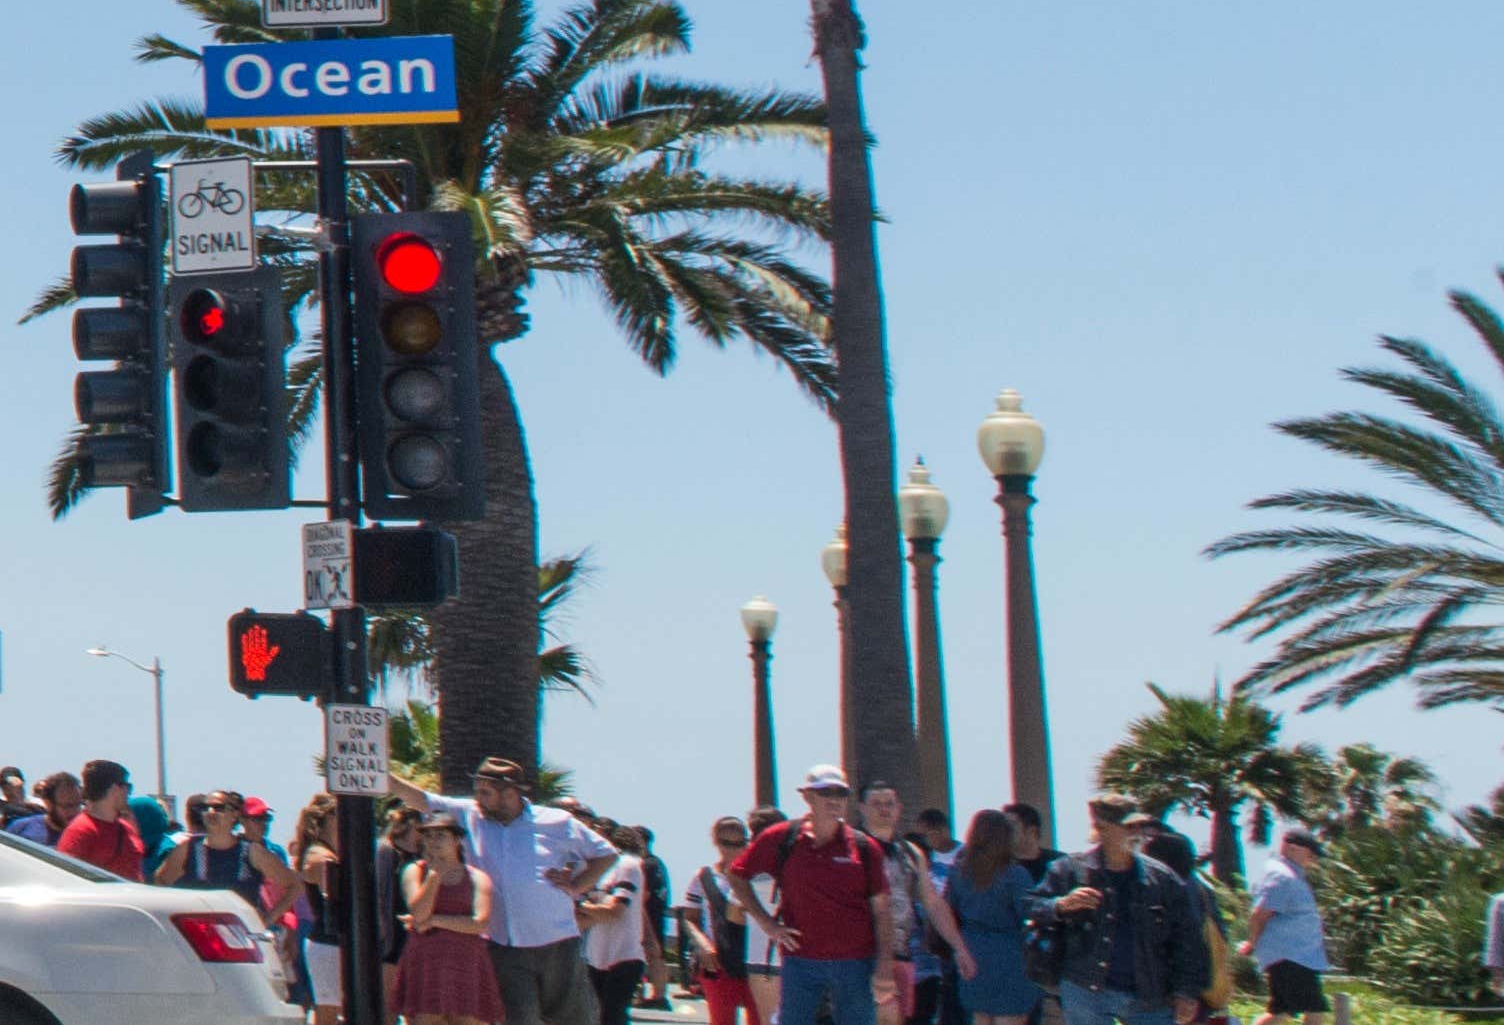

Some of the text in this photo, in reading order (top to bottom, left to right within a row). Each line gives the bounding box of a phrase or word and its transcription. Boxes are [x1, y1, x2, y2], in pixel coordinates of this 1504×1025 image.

[223, 53, 437, 100] Ocean
[177, 230, 249, 256] SIGNAL
[331, 709, 383, 727] CROSS
[348, 727, 366, 740] ON
[336, 740, 378, 756] WALK
[330, 756, 386, 774] SIGNAL
[339, 773, 377, 790] ONLY
